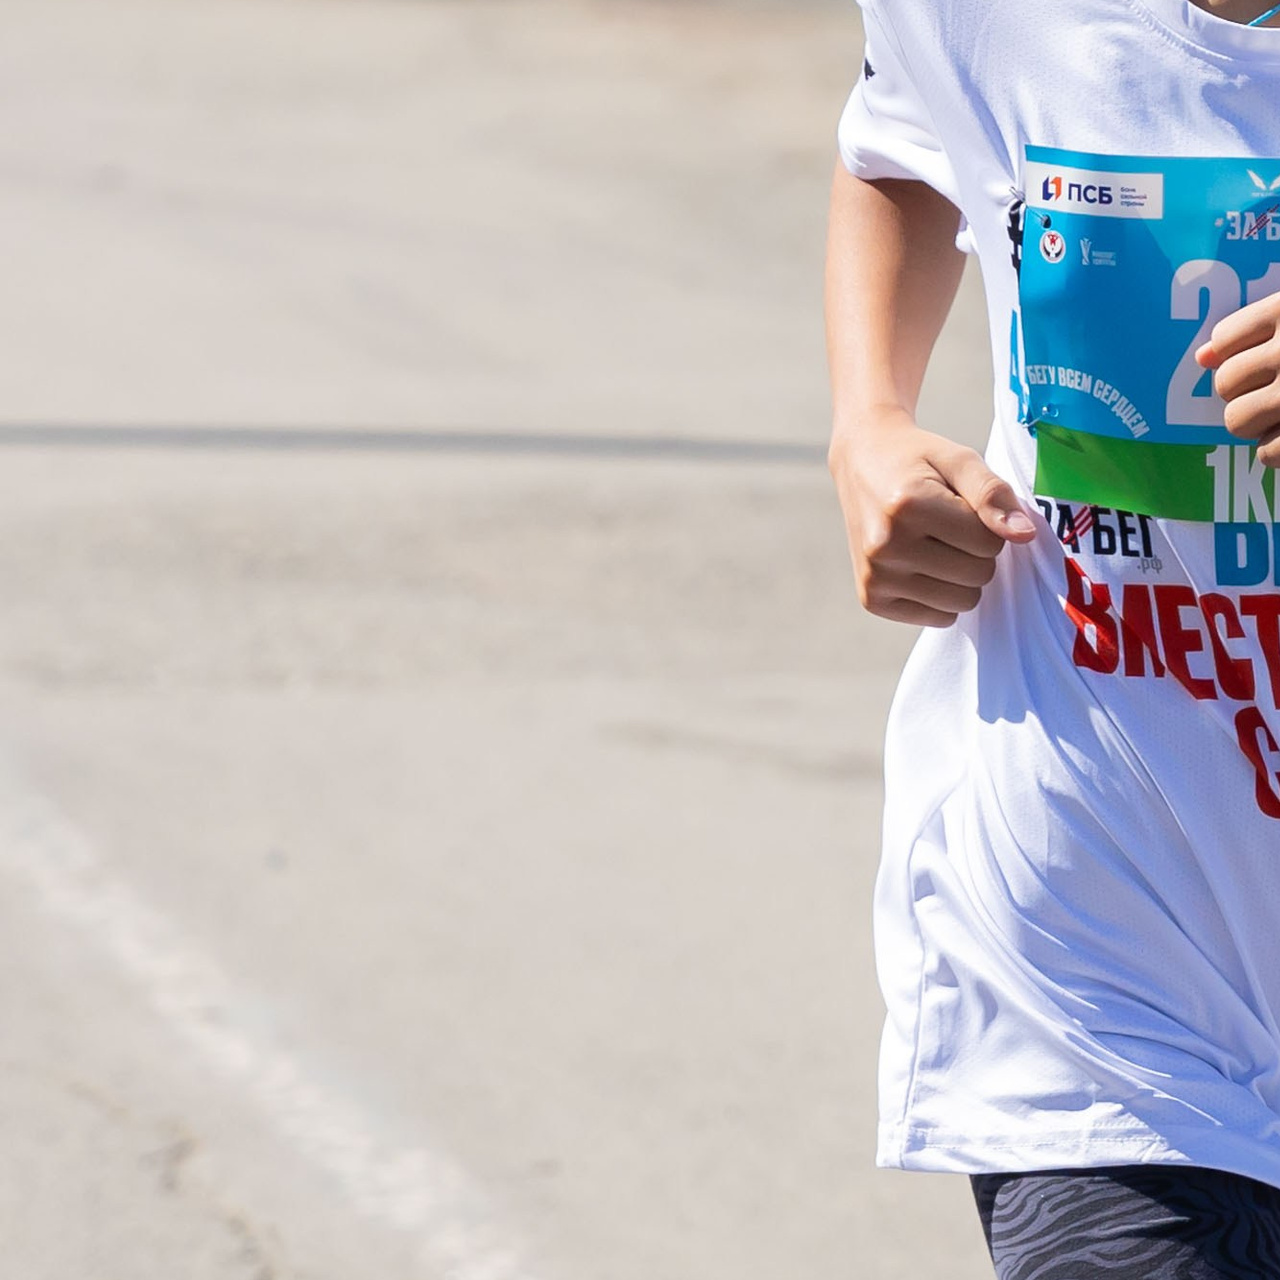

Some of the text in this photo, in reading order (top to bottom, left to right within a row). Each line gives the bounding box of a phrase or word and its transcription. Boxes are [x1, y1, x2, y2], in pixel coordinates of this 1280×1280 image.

[1068, 183, 1113, 205] ПСБ
[1027, 364, 1150, 438] БЕГУ ВСЕМ СЕРДЦЕМ
